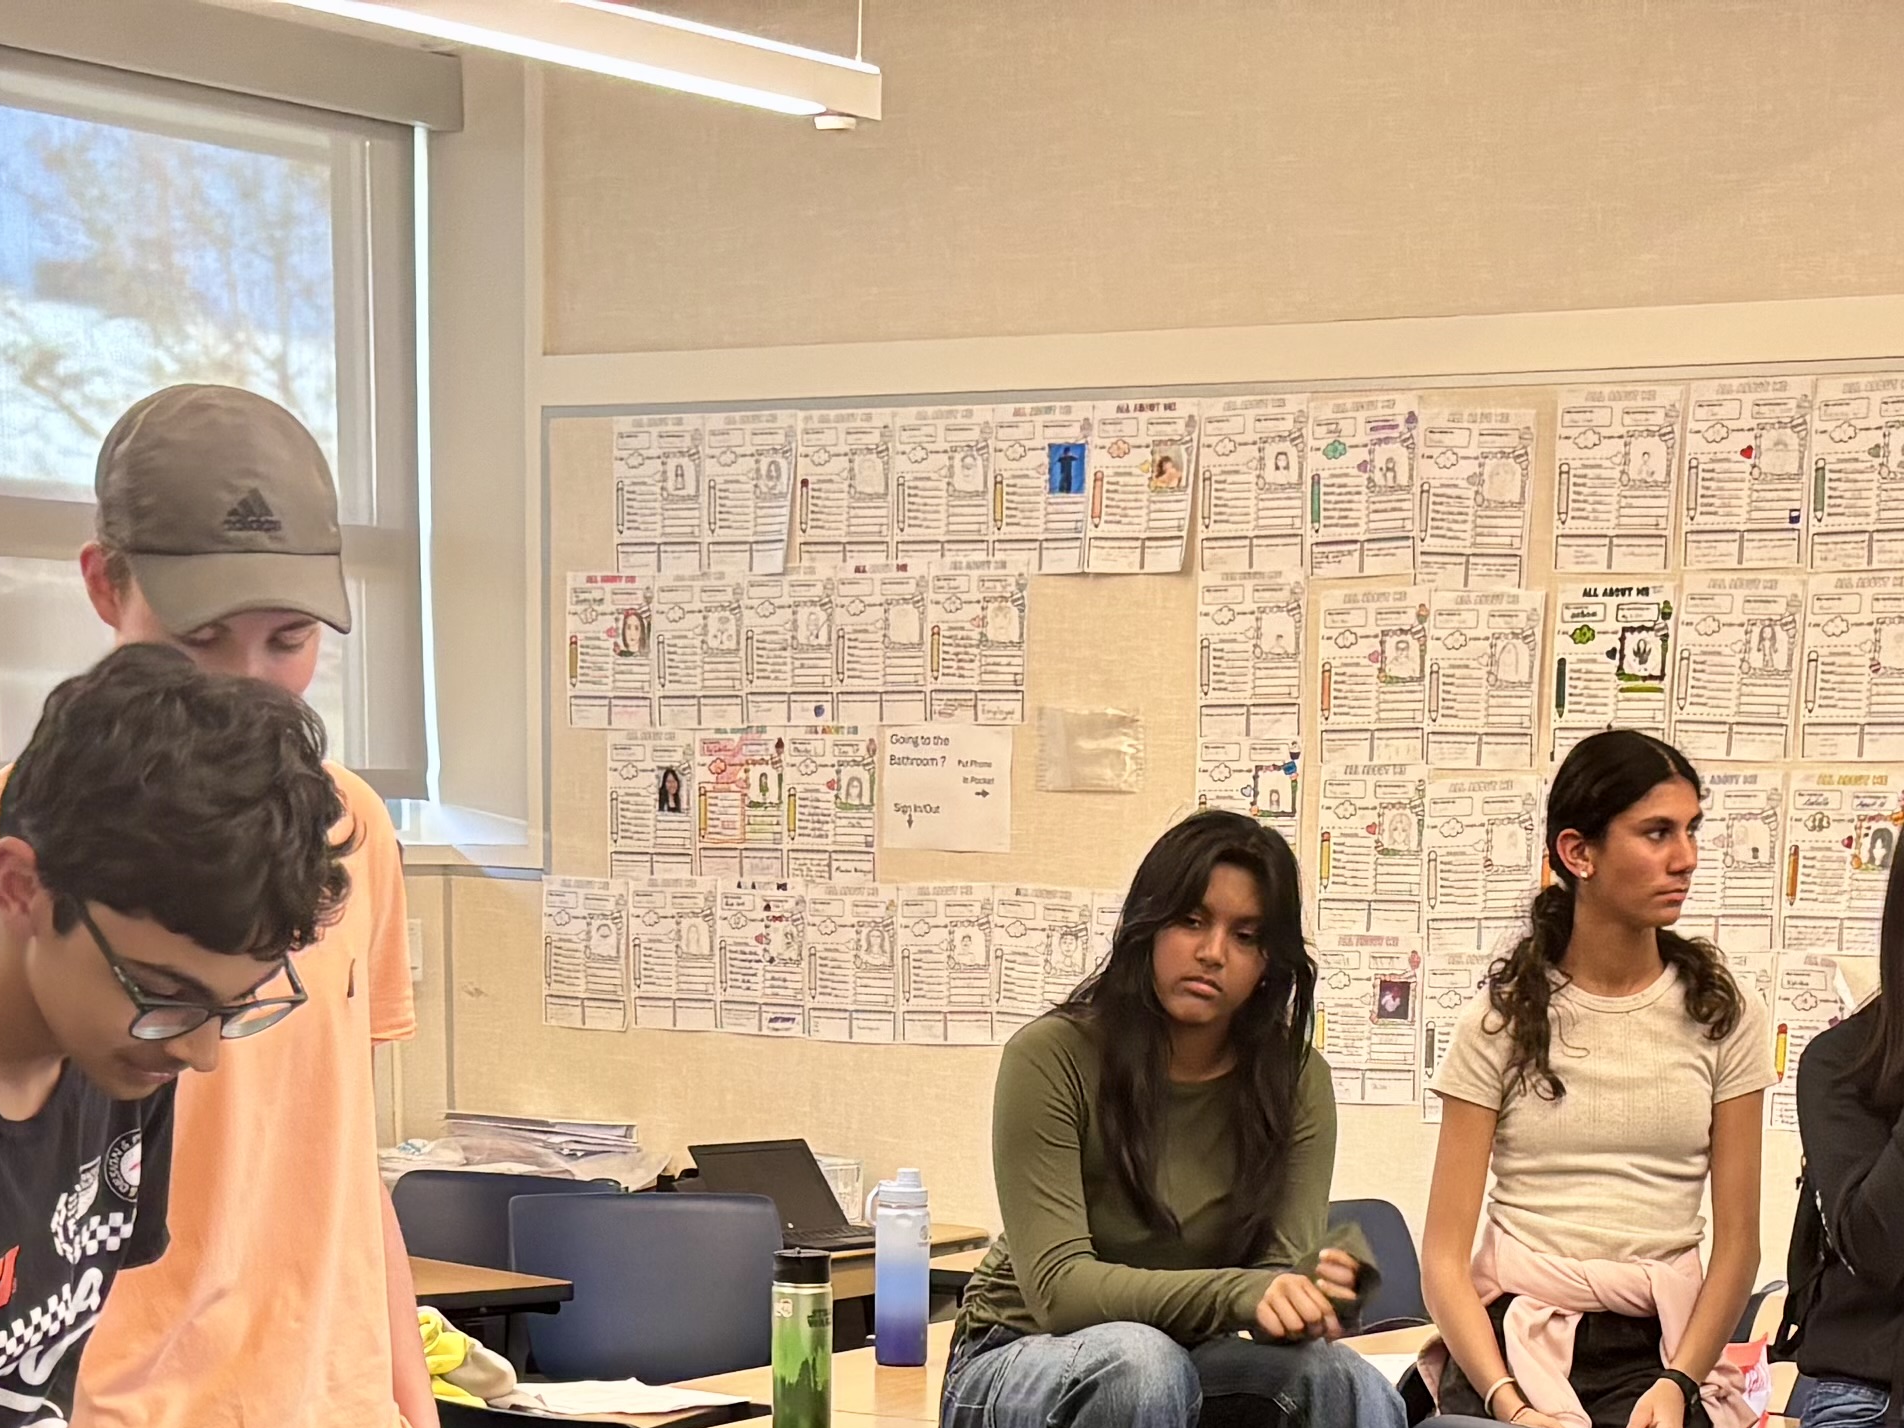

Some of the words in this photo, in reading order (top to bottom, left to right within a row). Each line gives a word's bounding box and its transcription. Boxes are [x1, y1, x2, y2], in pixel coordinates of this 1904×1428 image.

[1582, 587, 1599, 597] ALL
[1602, 587, 1633, 597] ABOUT
[1636, 586, 1649, 597] ME
[890, 734, 919, 748] Going
[921, 736, 931, 746] to
[933, 735, 950, 746] the
[889, 754, 938, 767] Bathroom
[893, 803, 912, 815] Sign
